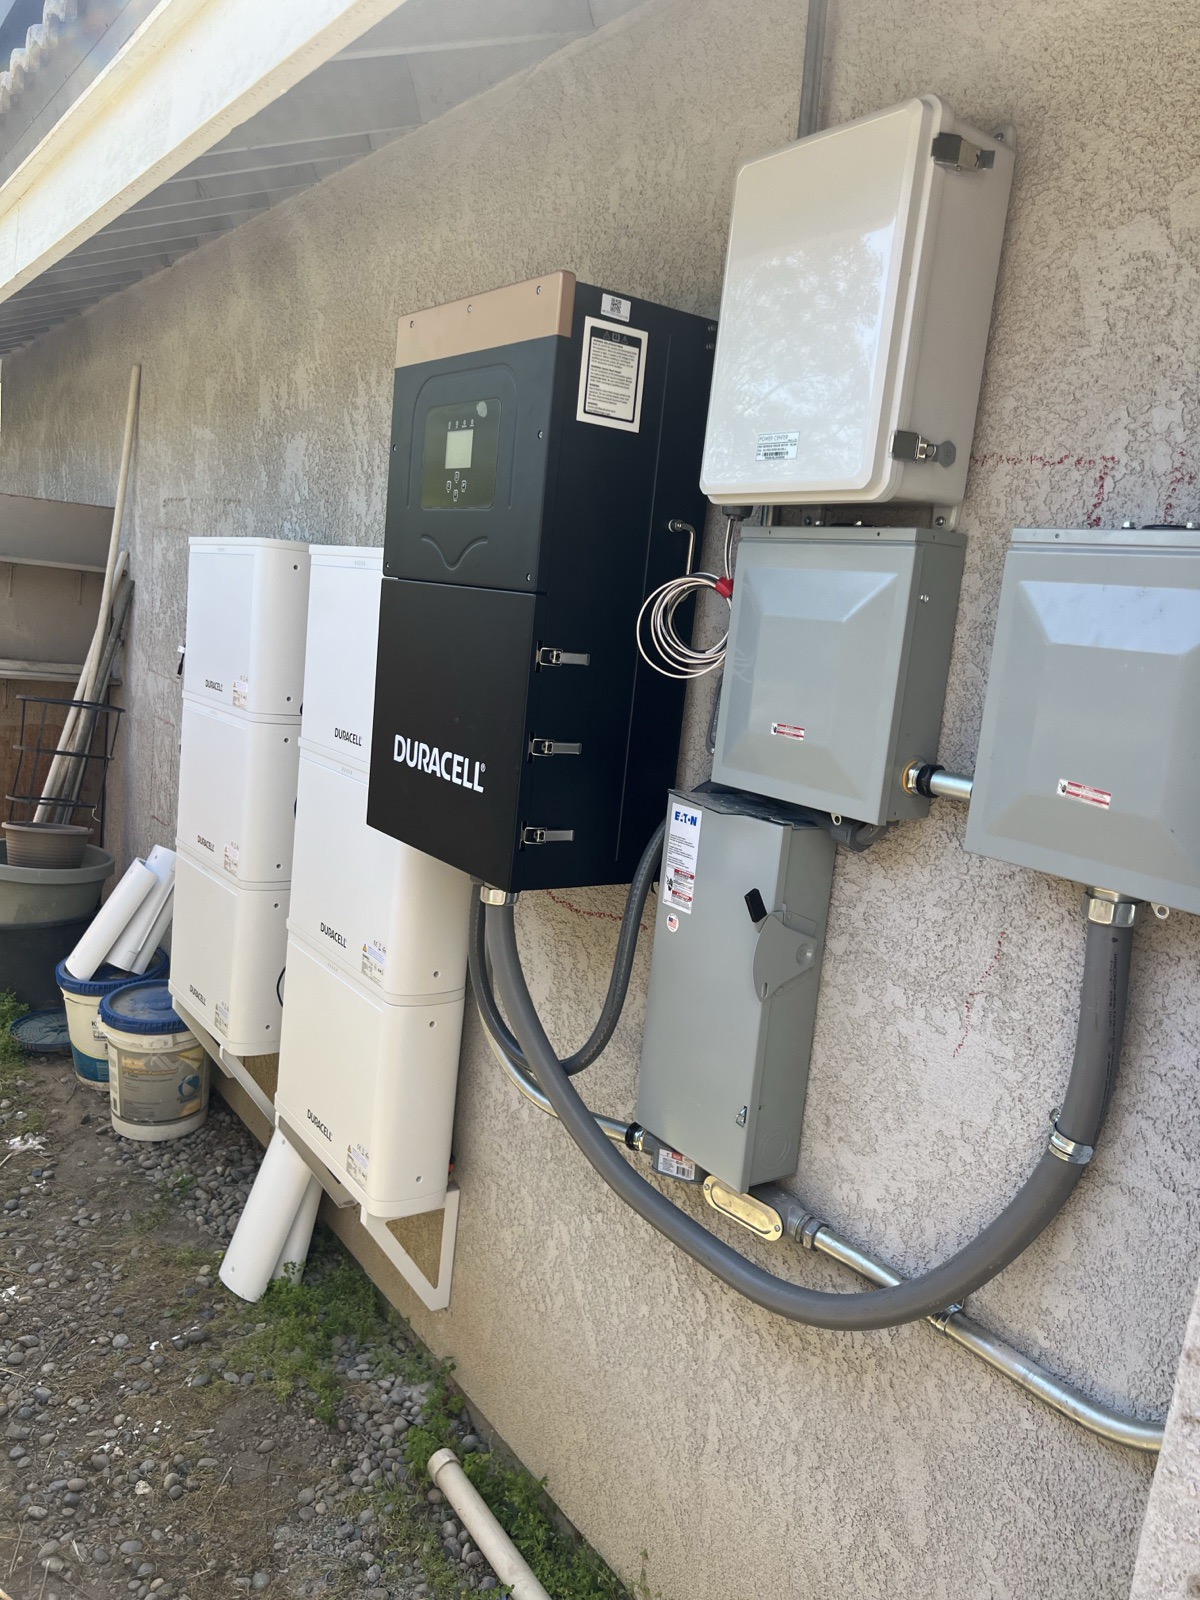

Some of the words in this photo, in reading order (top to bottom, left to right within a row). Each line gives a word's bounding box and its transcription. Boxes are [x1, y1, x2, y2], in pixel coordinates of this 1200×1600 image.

[205, 679, 223, 692] DURACELL
[334, 727, 362, 747] DURACELL
[197, 834, 215, 853] DURACELL
[320, 921, 347, 949] DURACELL
[189, 984, 207, 1007] DURACELL
[306, 1108, 332, 1143] DURACELL
